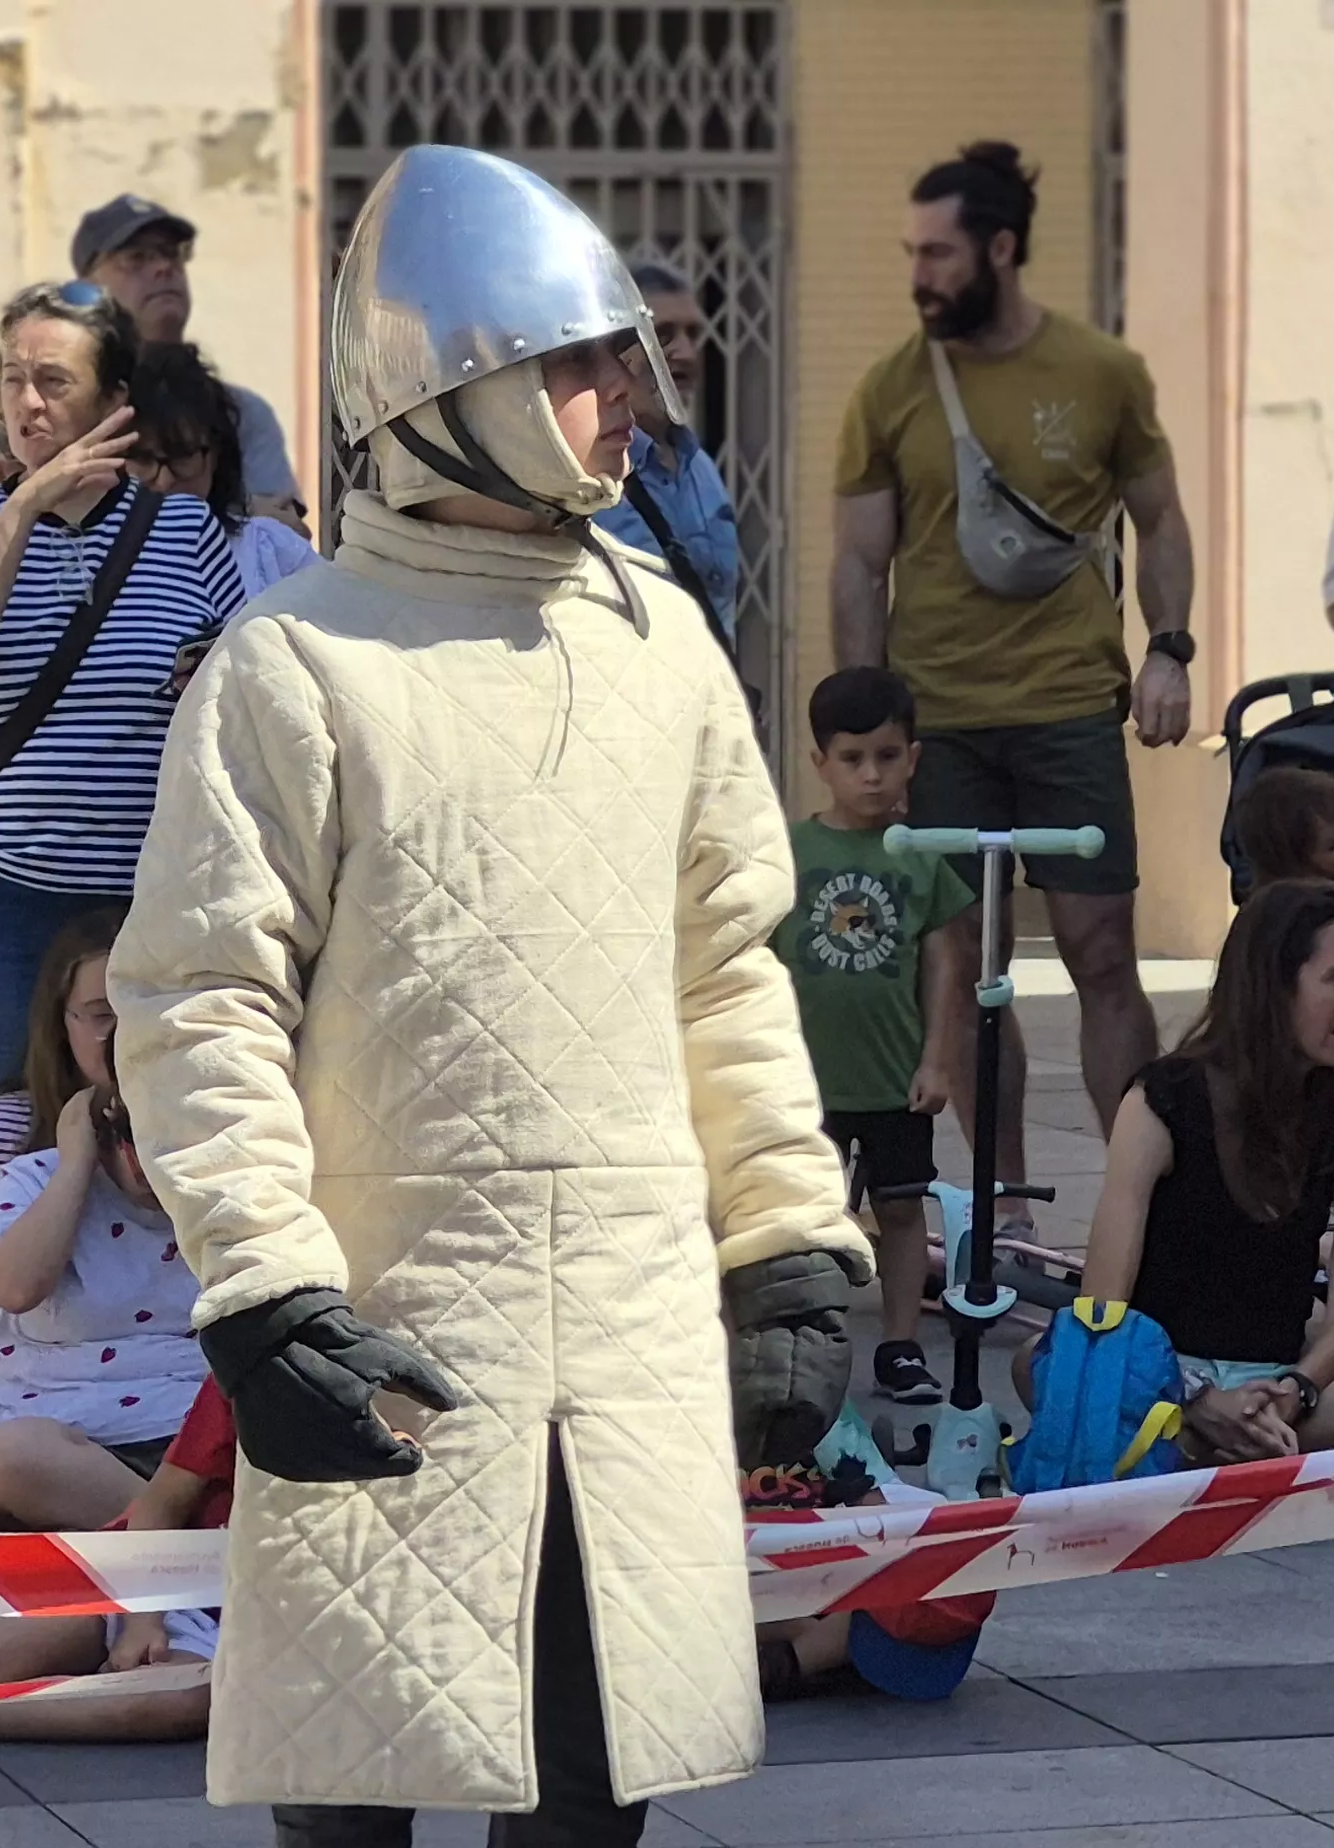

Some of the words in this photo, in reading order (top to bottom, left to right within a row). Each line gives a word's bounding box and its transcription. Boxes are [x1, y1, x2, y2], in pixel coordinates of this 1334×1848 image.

[810, 873, 856, 923] DESERT
[859, 874, 898, 926] ROADS
[811, 933, 851, 970] DUST
[853, 934, 897, 972] CALLS
